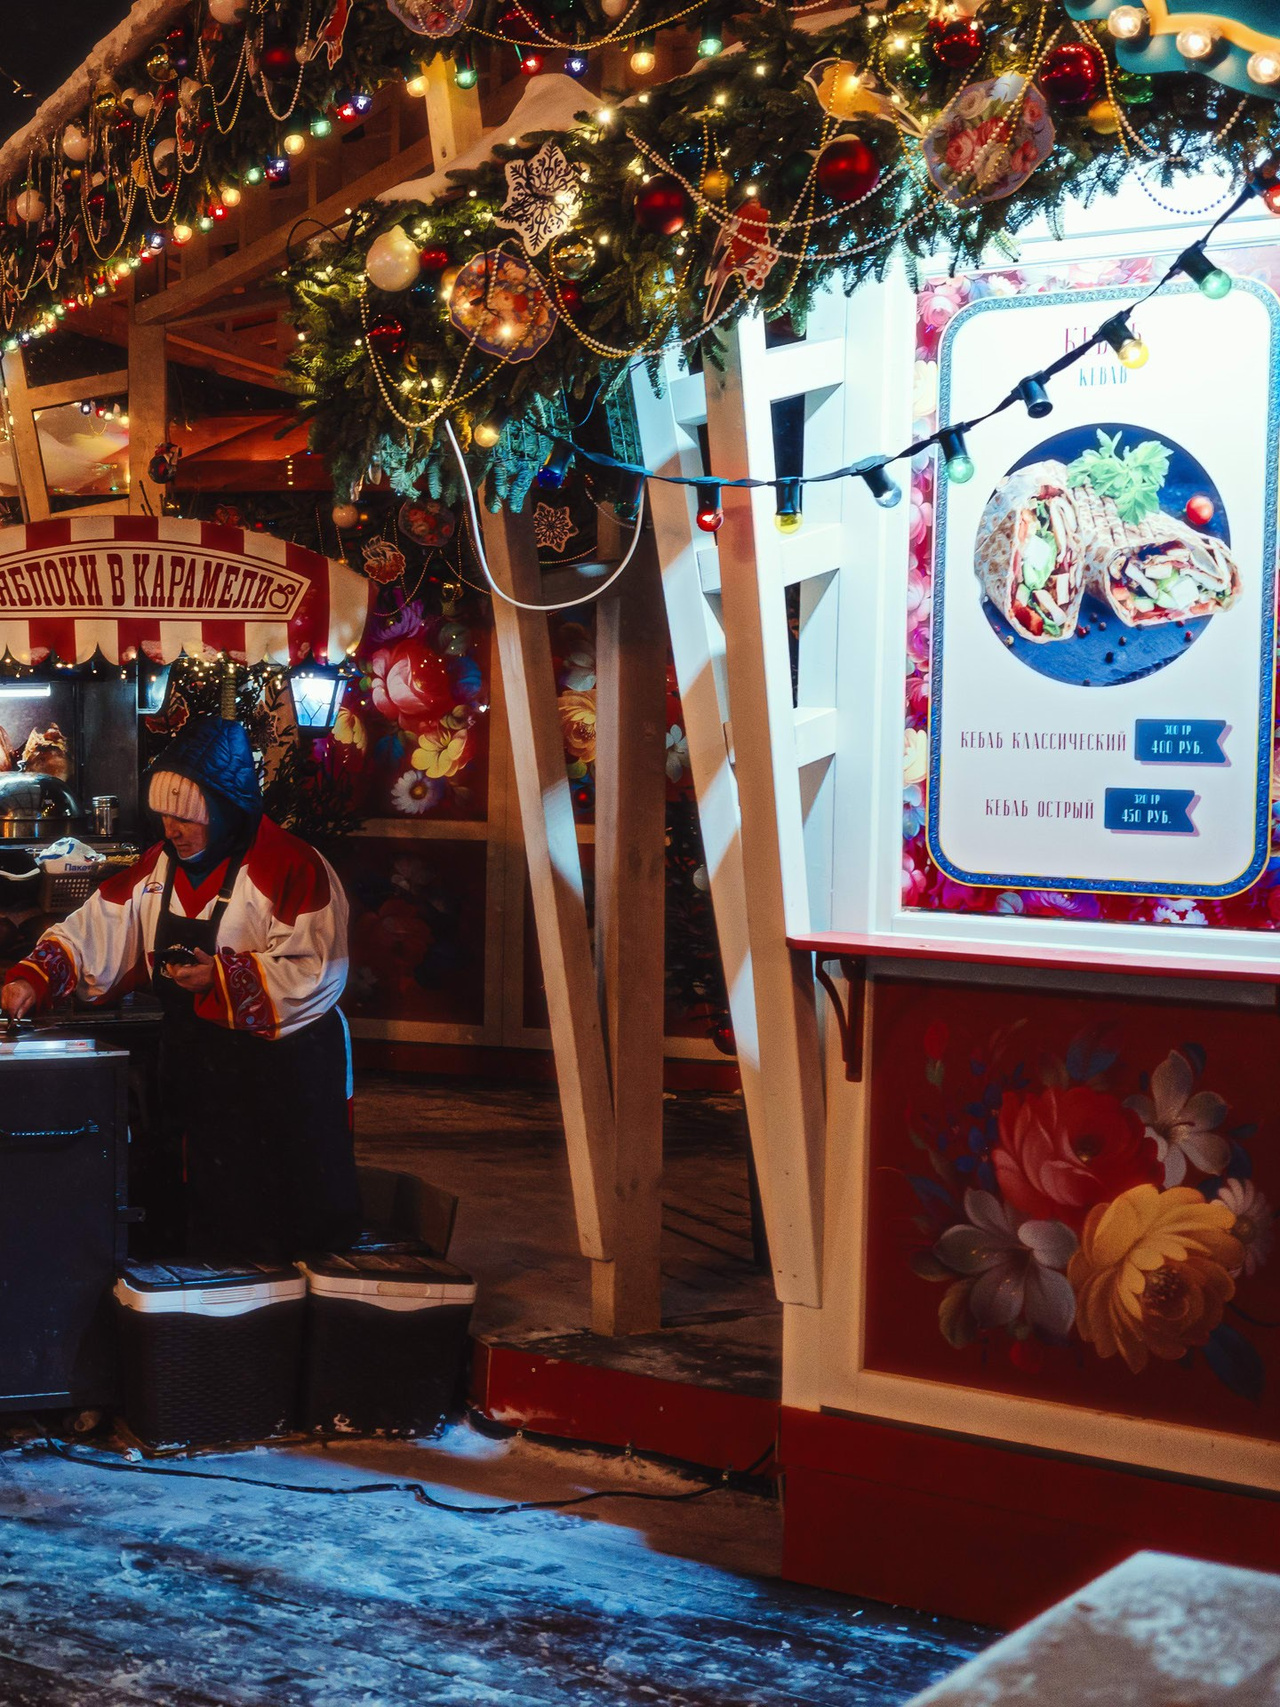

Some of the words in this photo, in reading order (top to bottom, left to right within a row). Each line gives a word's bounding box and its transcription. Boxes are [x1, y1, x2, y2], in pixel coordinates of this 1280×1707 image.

[106, 553, 125, 607] В
[132, 553, 275, 609] КАРАМЕЛИ
[960, 731, 1003, 749] КЕБАБ
[1012, 730, 1127, 751] КЛАССИЧЕСКИЙ
[1151, 740, 1173, 754] 400
[1179, 740, 1204, 755] РУБ.
[985, 798, 1029, 817] КЕБАБ
[1037, 798, 1094, 819] ОСТРЫЙ
[1121, 808, 1142, 823] 450
[1147, 809, 1172, 824] РУБ.
